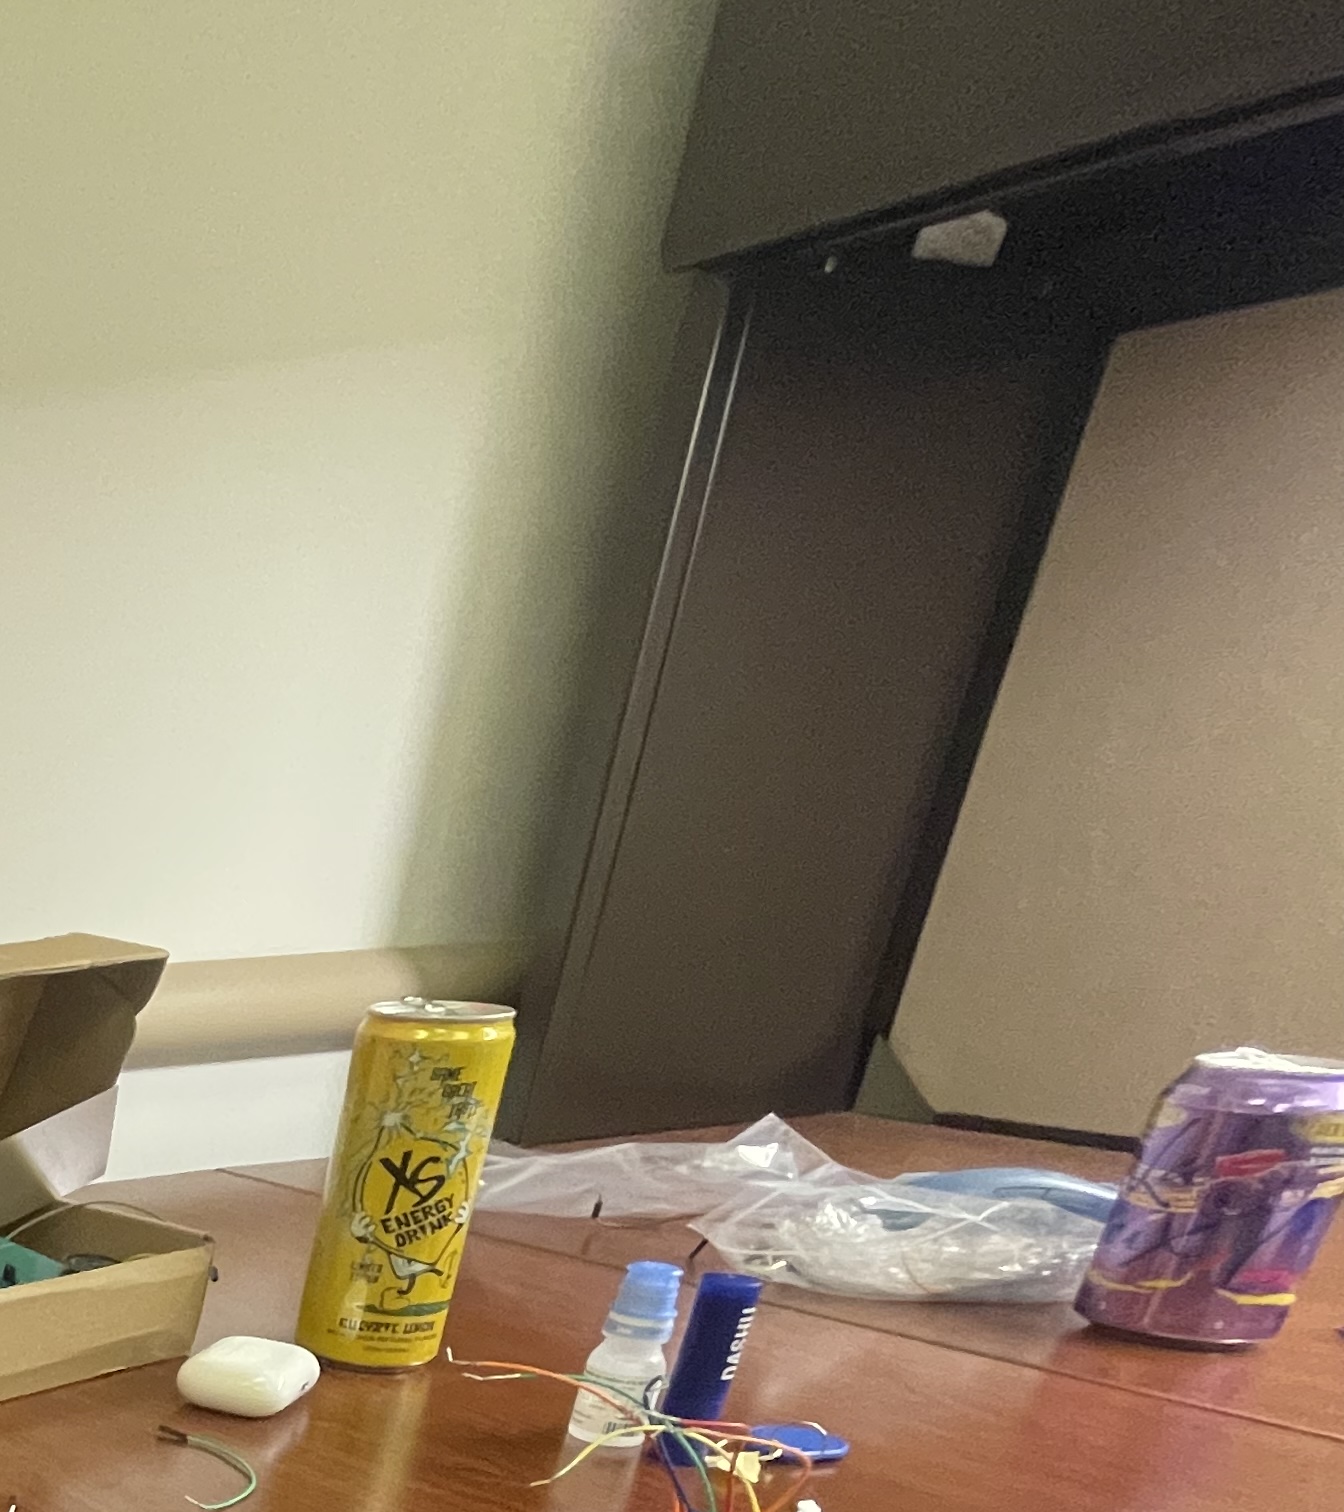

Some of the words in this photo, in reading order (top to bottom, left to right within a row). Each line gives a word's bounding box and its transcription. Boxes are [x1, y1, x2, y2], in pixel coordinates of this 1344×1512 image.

[379, 1150, 445, 1215] XS
[380, 1193, 455, 1234] ENERGY
[394, 1211, 453, 1248] DRINK
